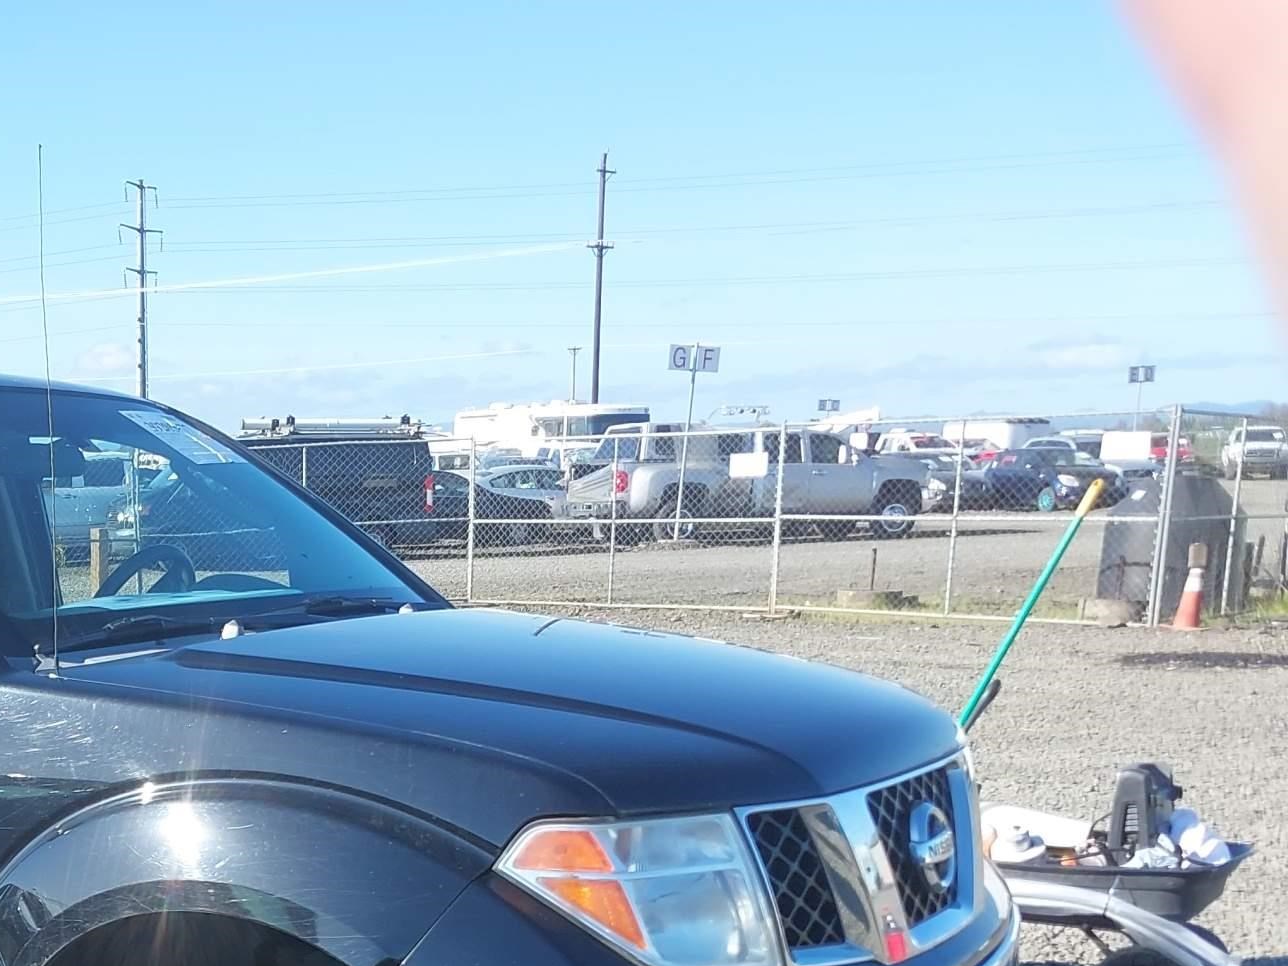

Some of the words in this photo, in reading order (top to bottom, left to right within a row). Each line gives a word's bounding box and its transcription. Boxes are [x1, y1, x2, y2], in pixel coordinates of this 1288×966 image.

[673, 347, 686, 368] G
[703, 349, 714, 369] F
[928, 837, 952, 857] NISS
